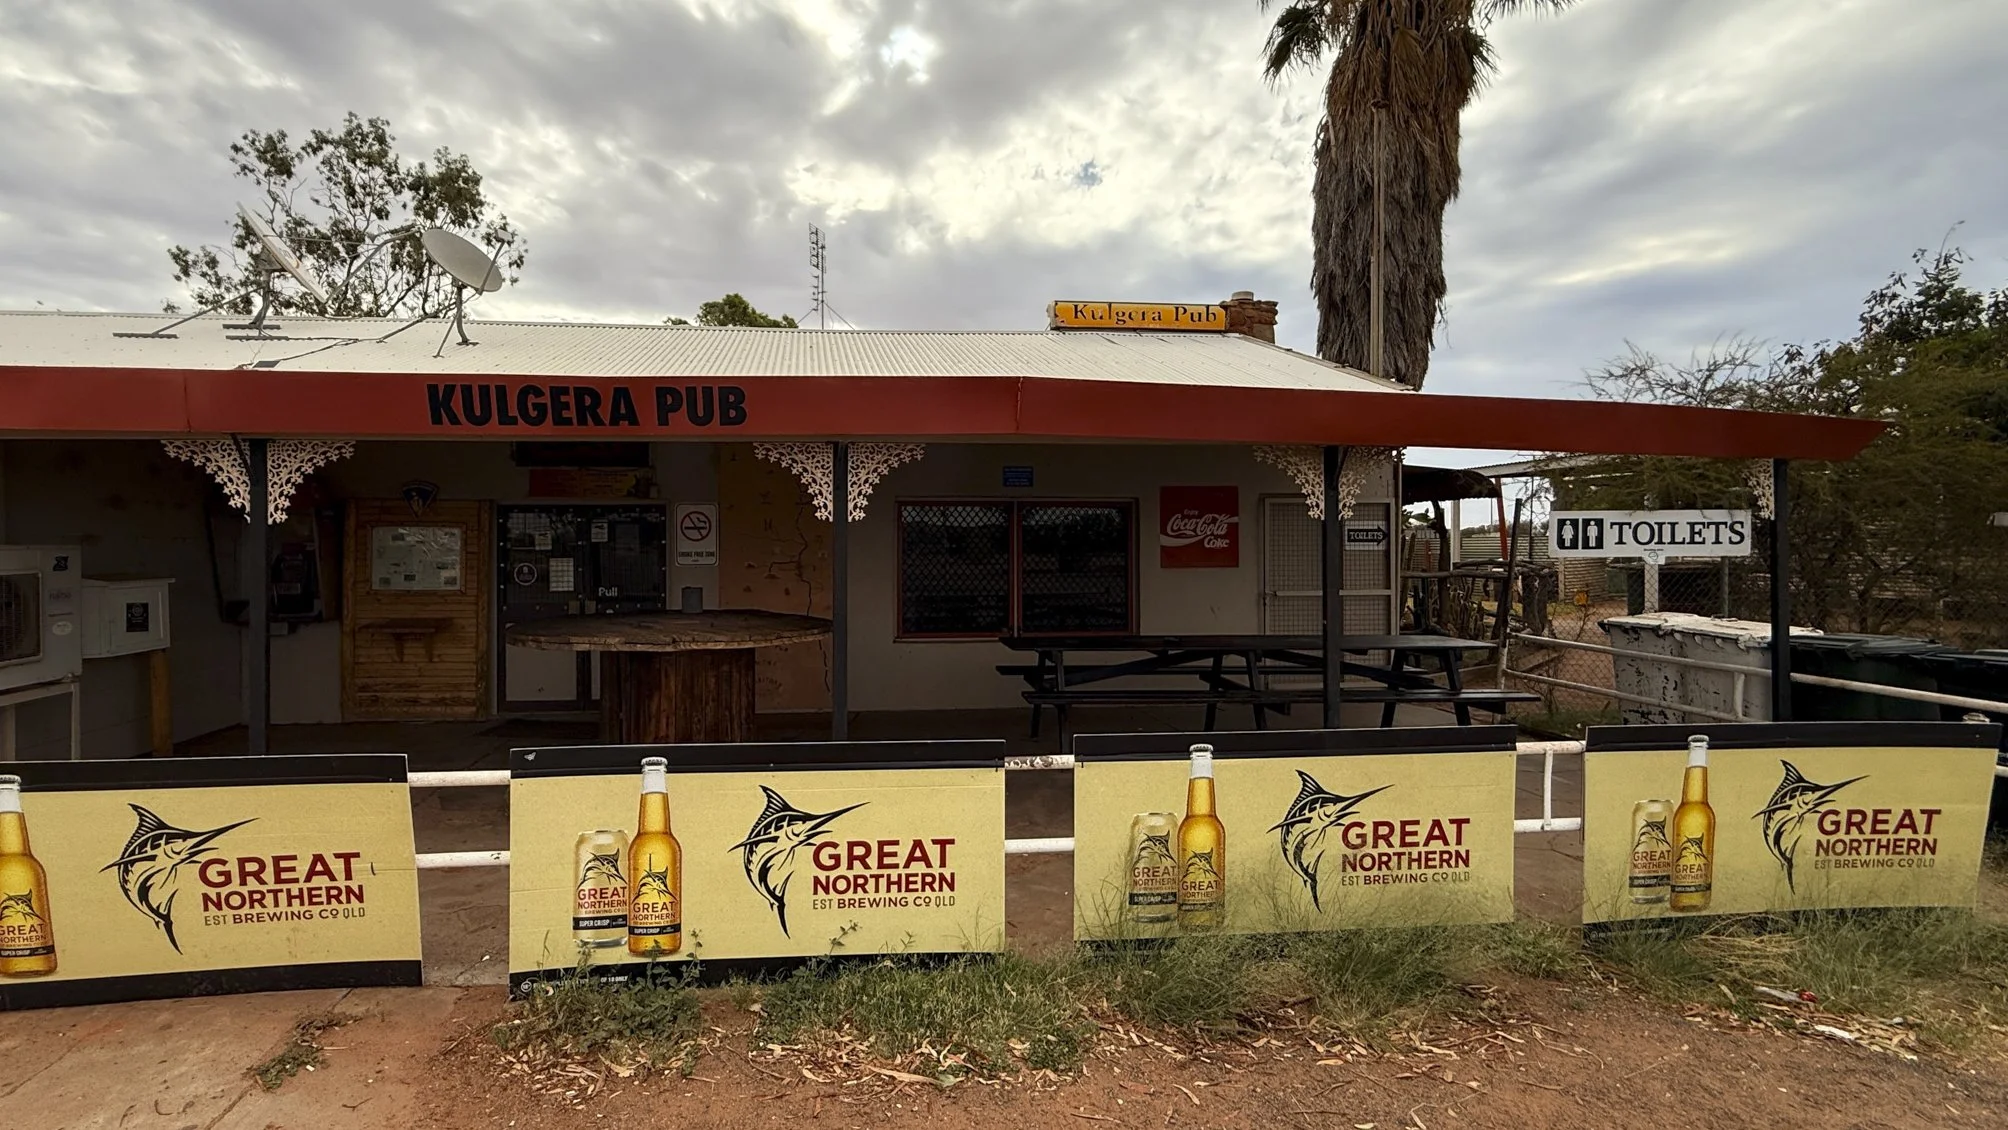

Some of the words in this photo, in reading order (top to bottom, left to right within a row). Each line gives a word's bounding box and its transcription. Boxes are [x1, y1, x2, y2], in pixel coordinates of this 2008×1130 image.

[1072, 303, 1162, 325] Kulgera
[1173, 304, 1217, 322] Pub
[426, 383, 640, 426] KULGERA
[655, 386, 747, 426] PUB
[1167, 513, 1230, 536] Coca-Cola
[1349, 531, 1383, 540] TOILETS
[1610, 520, 1745, 545] TOILETS
[1203, 535, 1231, 549] Coke
[598, 586, 618, 597] Pull
[1817, 809, 1942, 836] GREAT
[1342, 818, 1471, 850] GREAT
[813, 838, 956, 871] GREAT
[1815, 838, 1938, 857] NORTHERN
[1341, 849, 1470, 872] NORTHERN
[1633, 850, 1671, 862] GREAT
[1833, 858, 1894, 869] BREWING
[198, 852, 361, 888] GREAT
[1133, 866, 1176, 878] GREAT
[813, 872, 956, 895] NORTHERN
[1181, 879, 1219, 891] GREAT
[1341, 875, 1360, 886] EST
[1363, 873, 1428, 885] BREWING
[201, 884, 365, 912] NORTHERN
[578, 886, 627, 900] GREAT
[578, 899, 627, 909] NORTHERN
[633, 901, 675, 913] GREAT
[813, 898, 833, 910] EST
[837, 896, 909, 909] BREWING
[934, 895, 956, 907] QLD
[204, 914, 228, 926] EST
[232, 909, 314, 924] BREWING
[343, 906, 366, 918] QLD
[632, 912, 676, 921] NORTHERN
[0, 924, 44, 936] GREAT
